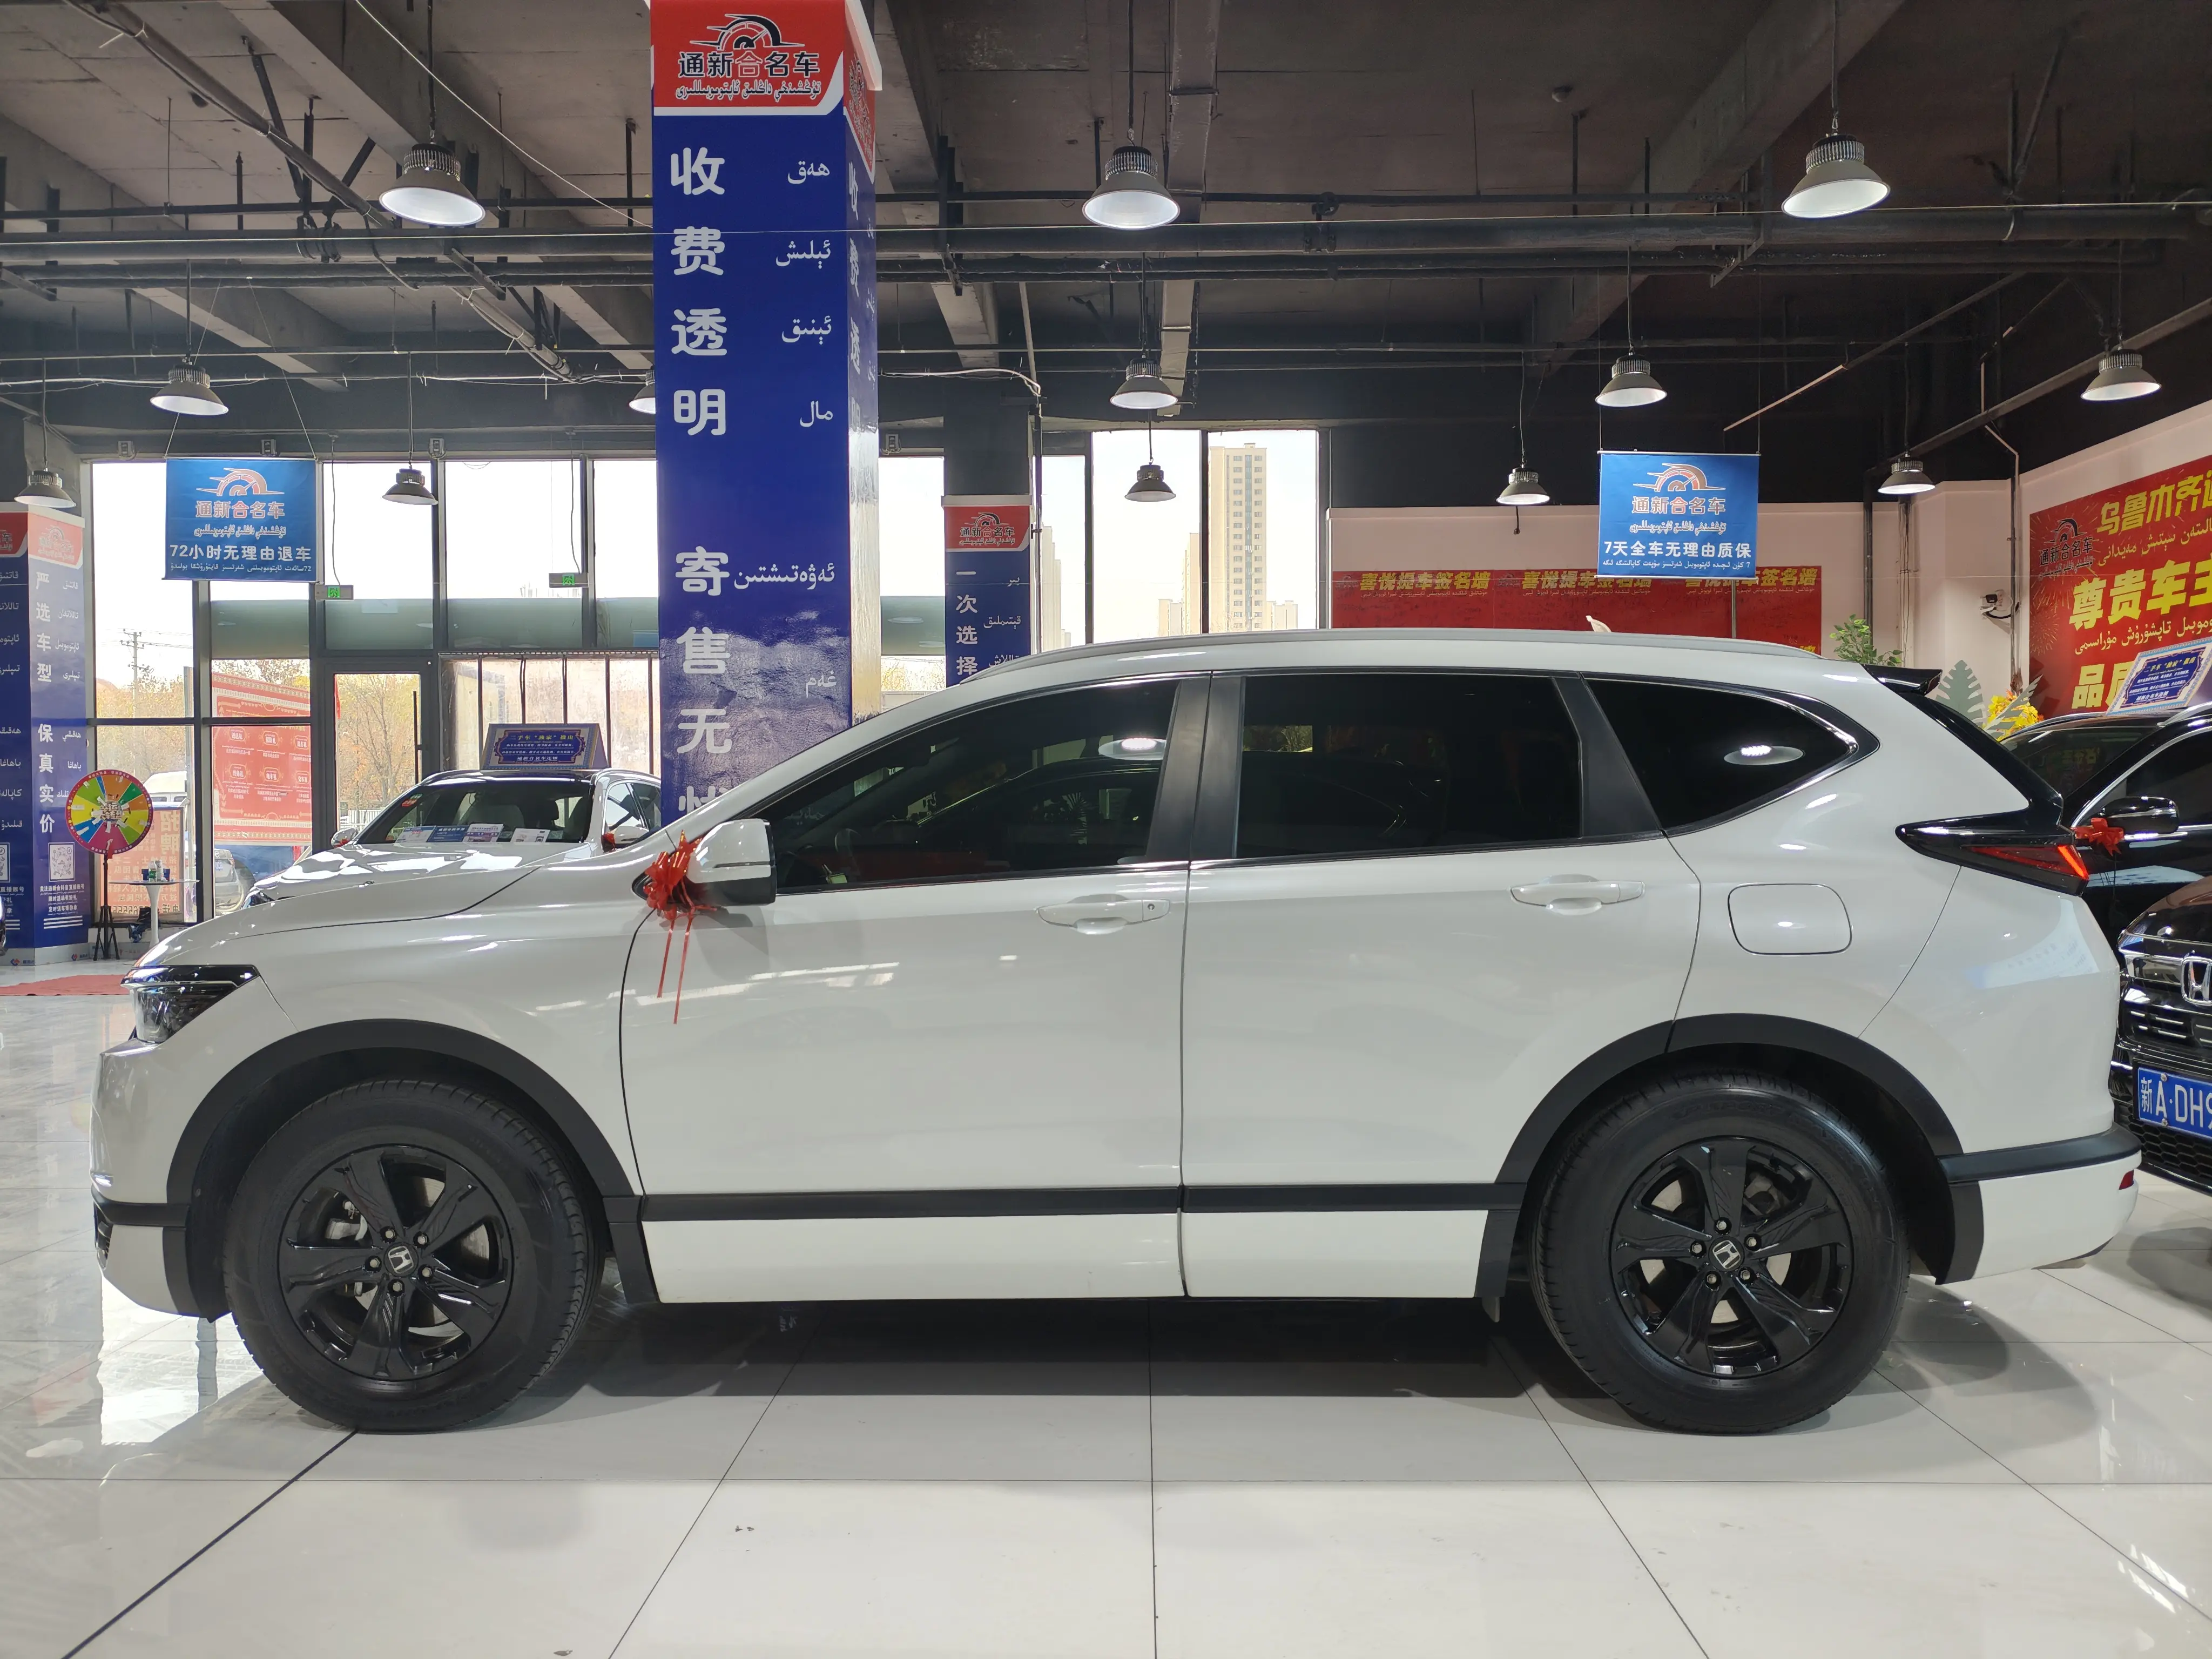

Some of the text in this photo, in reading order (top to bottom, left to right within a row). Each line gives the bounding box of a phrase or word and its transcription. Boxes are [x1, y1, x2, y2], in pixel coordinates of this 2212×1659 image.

[678, 51, 820, 78] 通新合名车
[671, 147, 727, 435] 收费透明
[195, 501, 285, 518] 通新合名车
[1632, 496, 1726, 515] 通新合名车
[960, 526, 1015, 537] 通新合名车
[170, 544, 311, 561] 72小时无理由退车
[1604, 541, 1751, 558] 7天全车无理由质保
[2039, 537, 2093, 566] 通新合名车
[36, 571, 52, 683] 严选车型
[38, 723, 55, 833] 保真实价
[2141, 1077, 2212, 1130] 新A·DH
